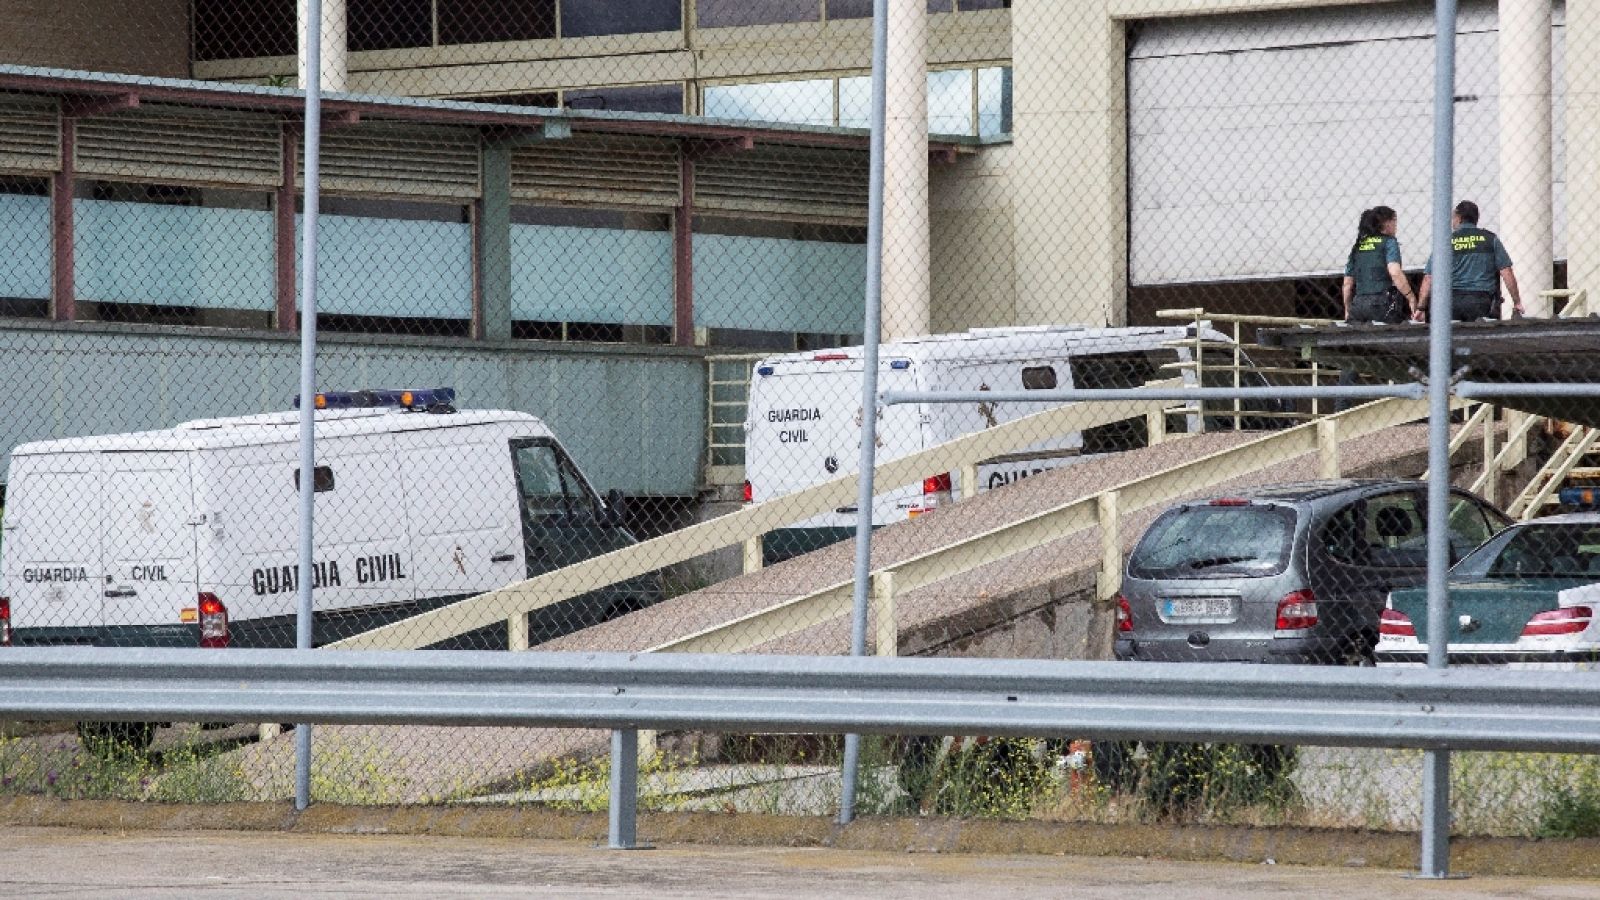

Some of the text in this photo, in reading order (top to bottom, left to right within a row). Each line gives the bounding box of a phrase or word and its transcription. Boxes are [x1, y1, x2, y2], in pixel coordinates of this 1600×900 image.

[1451, 235, 1485, 244] UARDIA
[1454, 242, 1476, 250] CIVIL
[768, 407, 821, 423] GUARDIA
[779, 430, 809, 443] CIVIL
[23, 565, 167, 583] GUARDIA CIVIL
[355, 552, 406, 584] CIVIL
